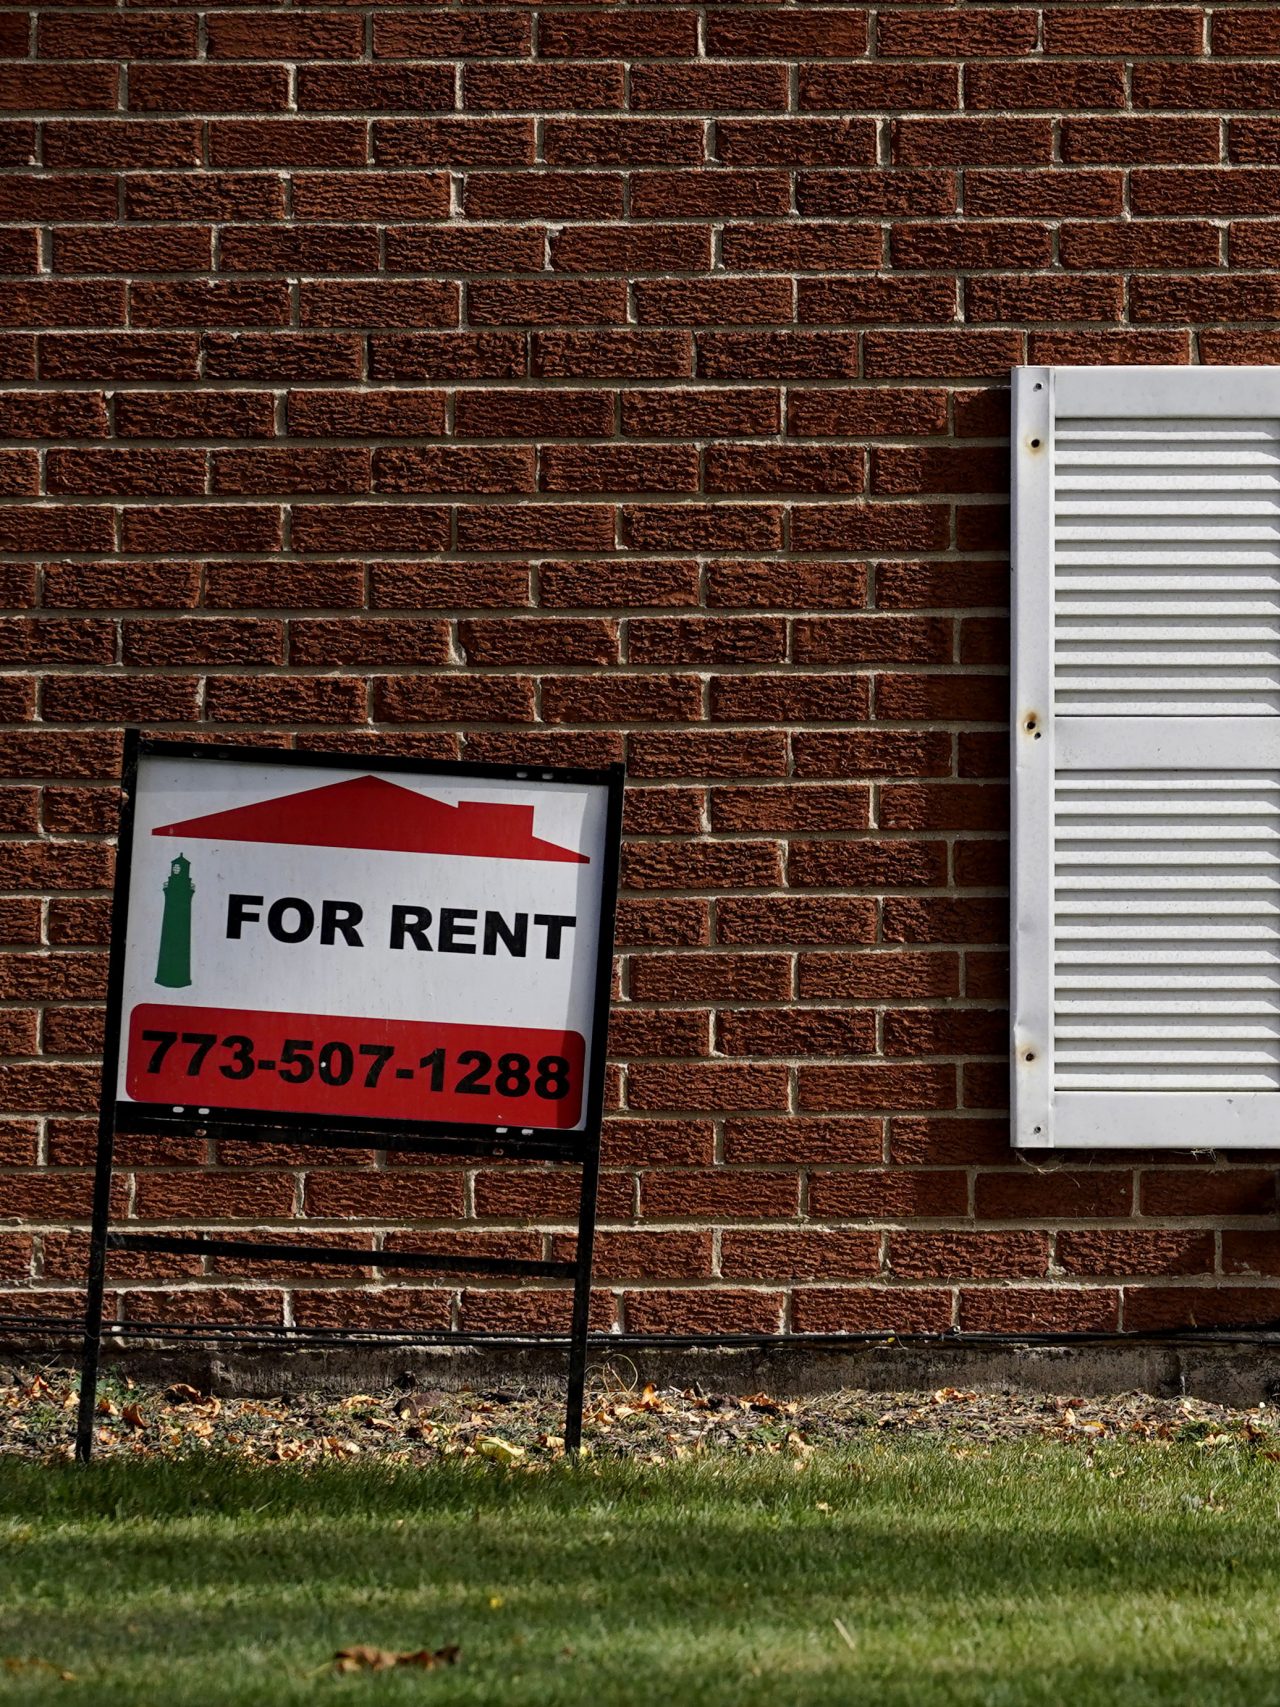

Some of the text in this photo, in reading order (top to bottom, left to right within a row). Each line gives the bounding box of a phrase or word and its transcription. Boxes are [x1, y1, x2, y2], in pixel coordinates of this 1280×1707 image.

[225, 893, 577, 960] FOR RENT
[141, 1030, 571, 1100] 773-507-1288
